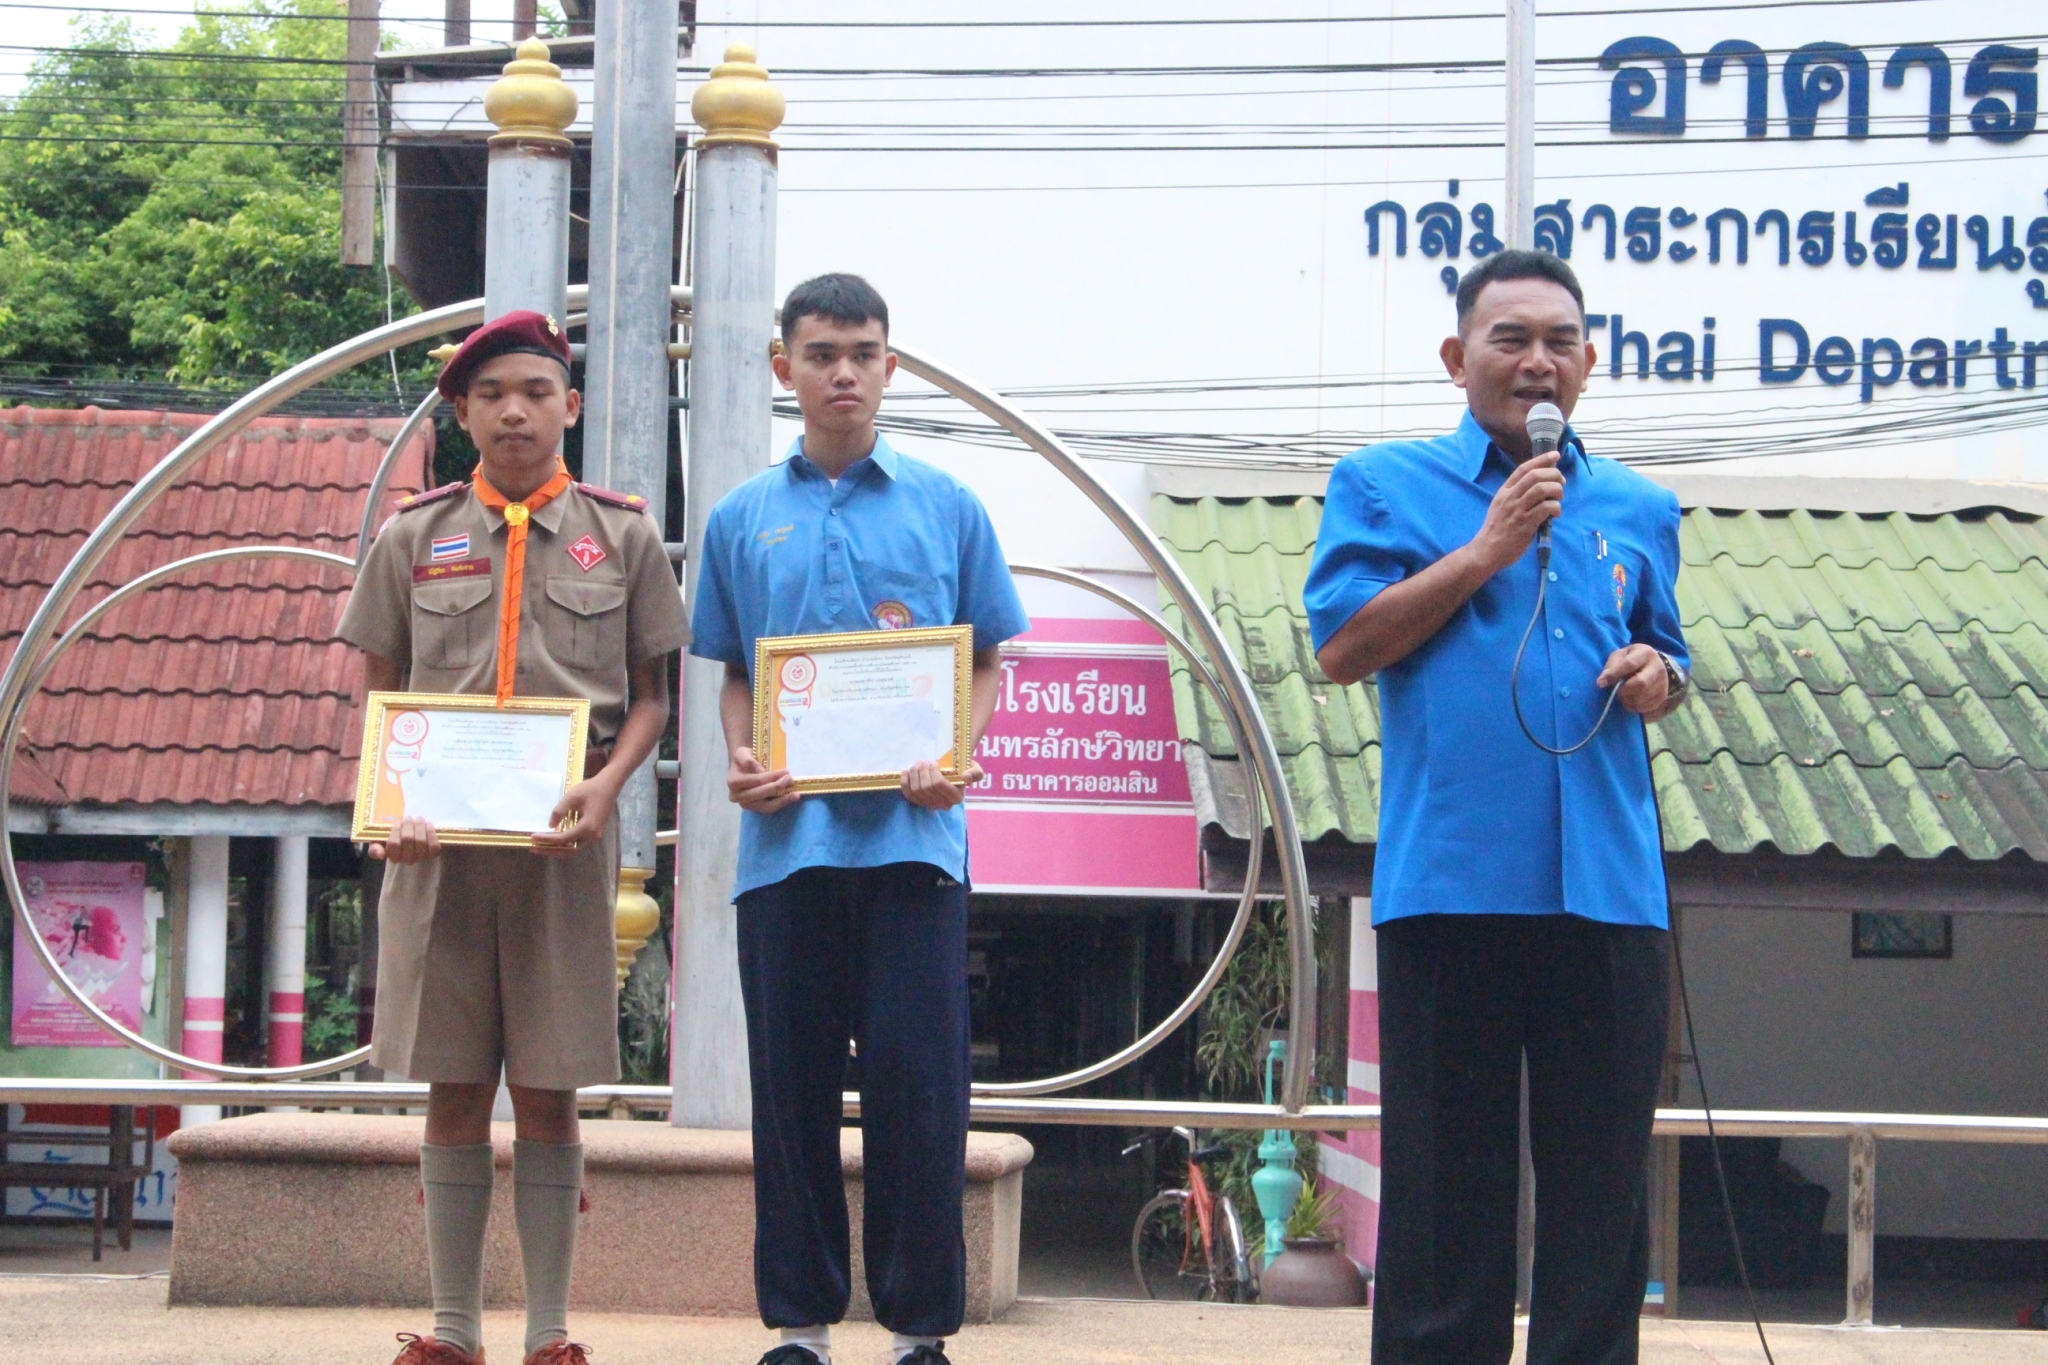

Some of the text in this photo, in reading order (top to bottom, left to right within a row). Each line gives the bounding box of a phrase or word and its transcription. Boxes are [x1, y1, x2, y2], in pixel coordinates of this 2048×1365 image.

[1600, 35, 2039, 144] อาคาร
[1364, 178, 2048, 309] กลุ่มสาระการเรียนรู
[994, 660, 1147, 716] โรงเรียน
[973, 728, 1182, 762] นทรลักษ์วิทยา
[1002, 770, 1158, 794] ธนาคารออมสิน
